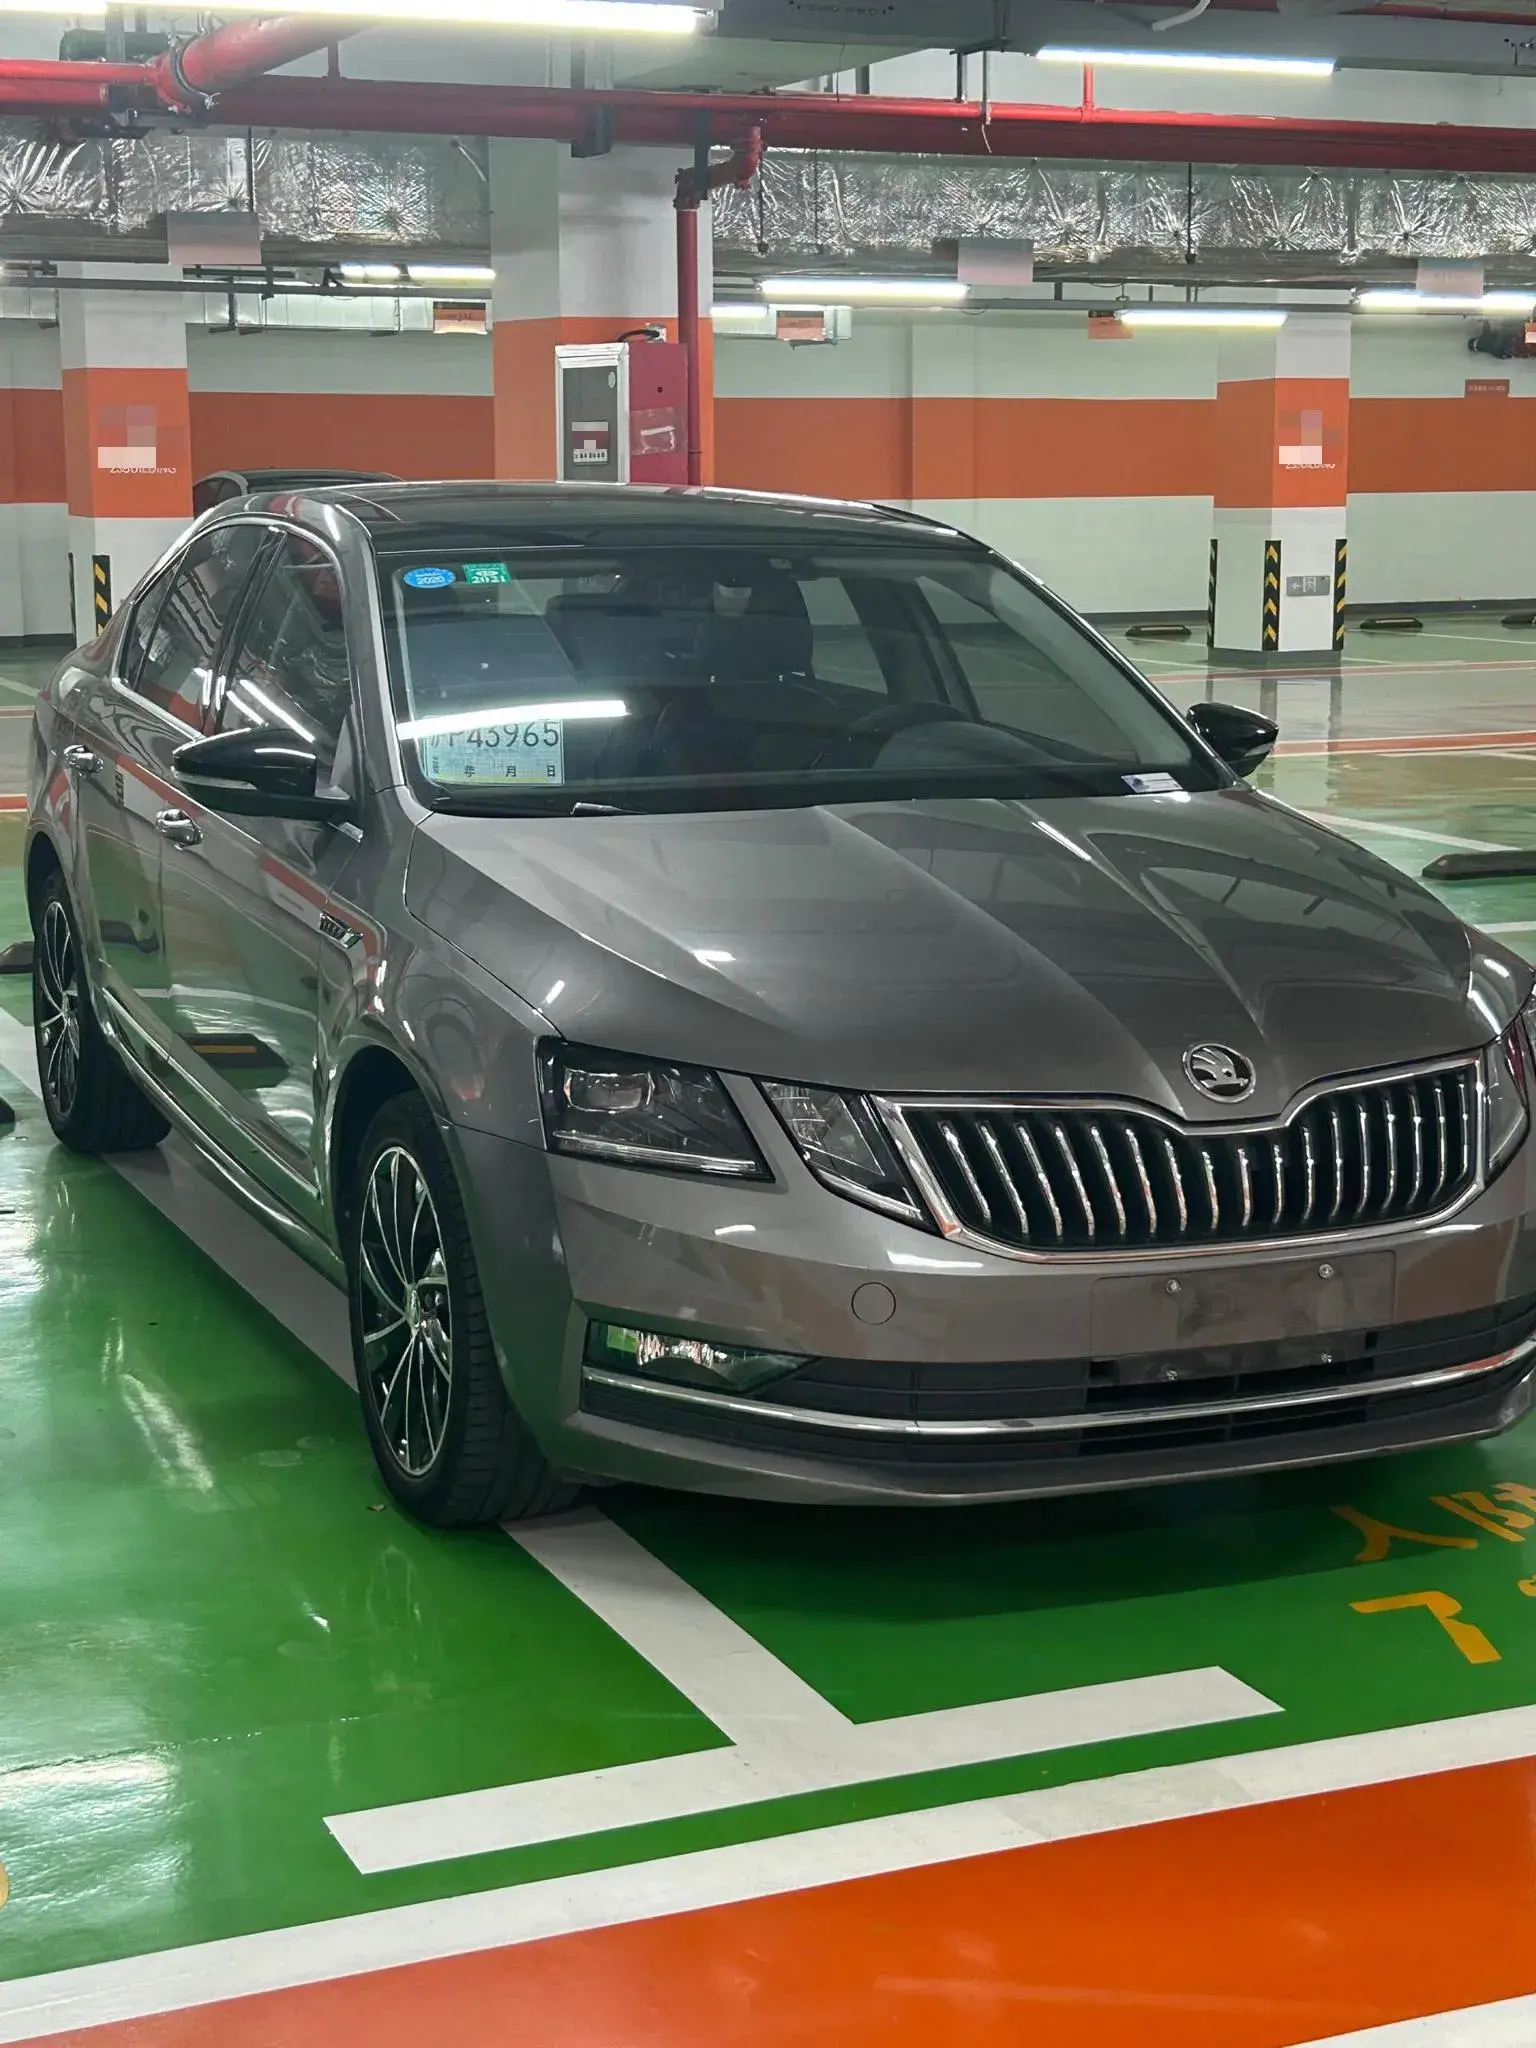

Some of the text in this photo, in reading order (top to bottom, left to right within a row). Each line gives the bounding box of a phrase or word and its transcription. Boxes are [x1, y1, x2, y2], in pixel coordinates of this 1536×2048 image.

[471, 575, 507, 584] 2021
[464, 764, 556, 778] 年 月 日
